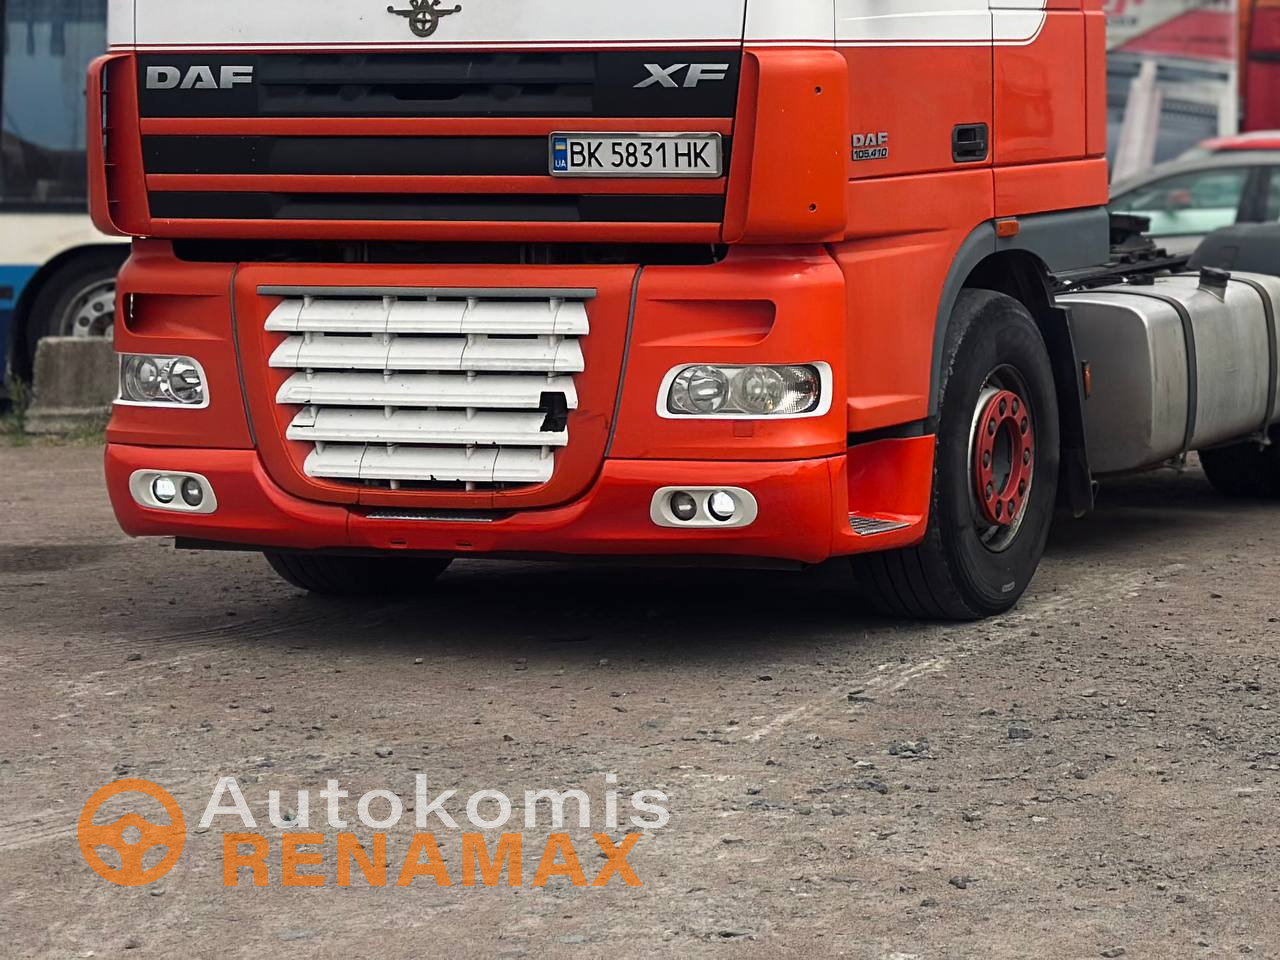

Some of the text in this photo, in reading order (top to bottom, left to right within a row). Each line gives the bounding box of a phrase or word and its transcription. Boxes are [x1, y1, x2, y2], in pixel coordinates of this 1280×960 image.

[145, 65, 254, 89] DAF
[633, 63, 729, 88] XF
[852, 132, 888, 147] DAF
[570, 142, 711, 168] BK 5831 HK
[853, 147, 888, 159] 105.410
[555, 160, 567, 168] UA
